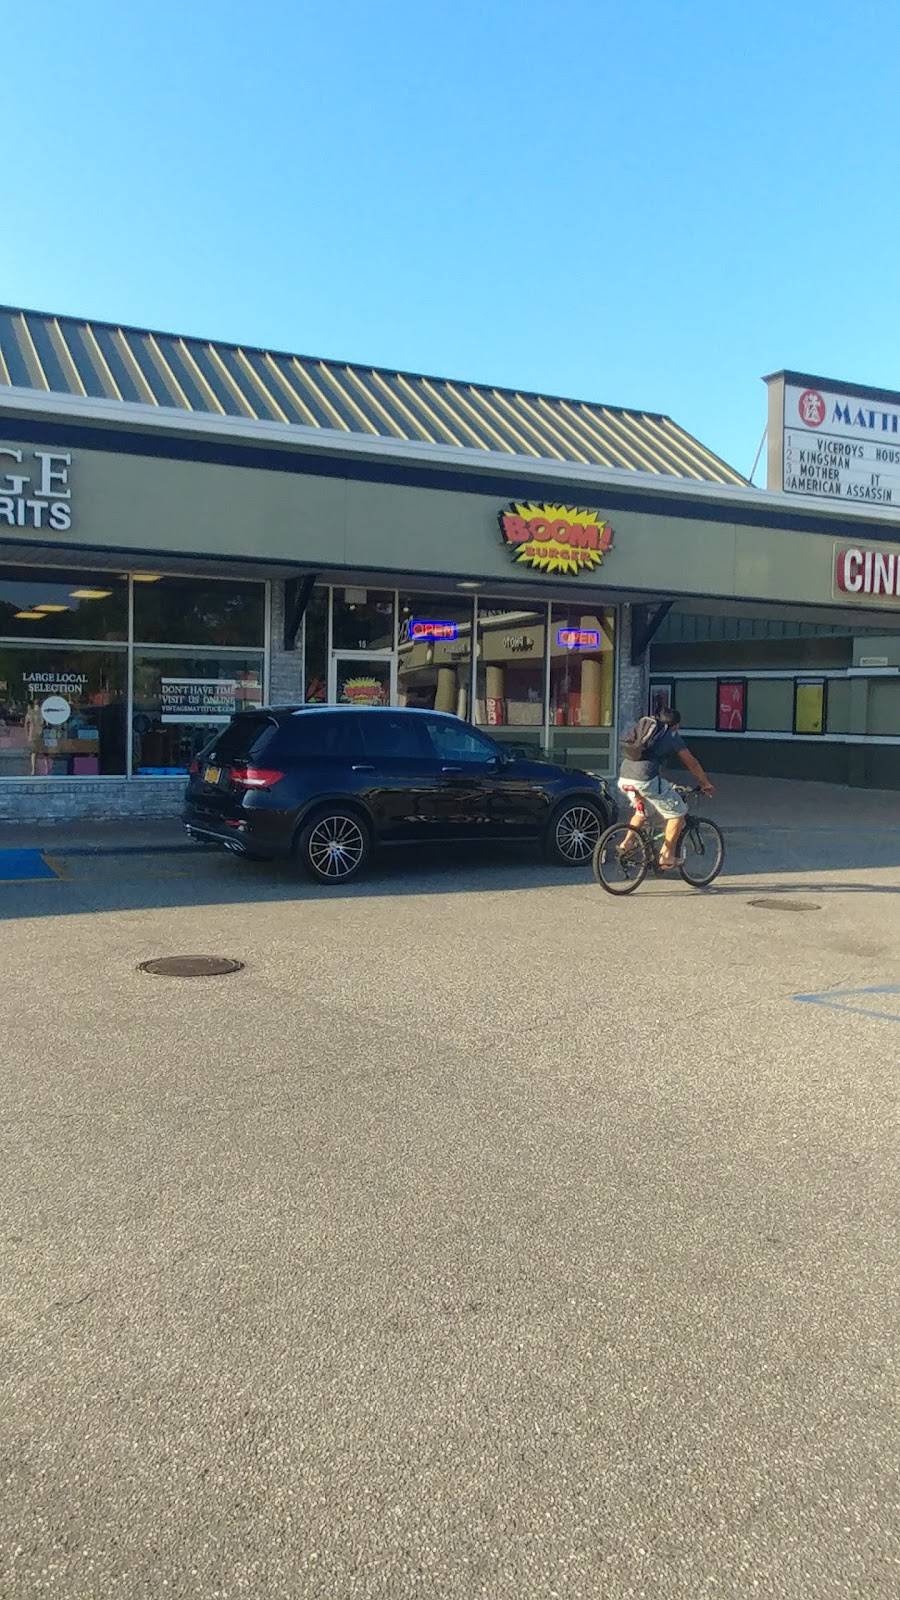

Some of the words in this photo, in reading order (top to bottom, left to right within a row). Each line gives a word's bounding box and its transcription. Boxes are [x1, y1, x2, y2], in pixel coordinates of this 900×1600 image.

[816, 438, 864, 458] VICEROYS
[799, 449, 850, 470] KINGSMAN
[0, 448, 71, 498] GE
[800, 464, 841, 482] MOTHER
[870, 474, 881, 487] IT
[791, 476, 841, 494] AMERICAN
[847, 485, 892, 502] ASSASSIN
[0, 497, 71, 530] RITS
[502, 516, 613, 552] BOOM!
[525, 546, 591, 562] BURGER
[413, 623, 454, 638] OPEN
[23, 672, 54, 682] LARGE
[56, 674, 88, 683] LOCAL
[28, 683, 82, 694] SELECTION
[191, 686, 214, 695] HAVE
[215, 686, 236, 695] TIME
[161, 695, 186, 704] VISIT
[188, 696, 200, 705] US
[202, 696, 236, 705] ONLINE
